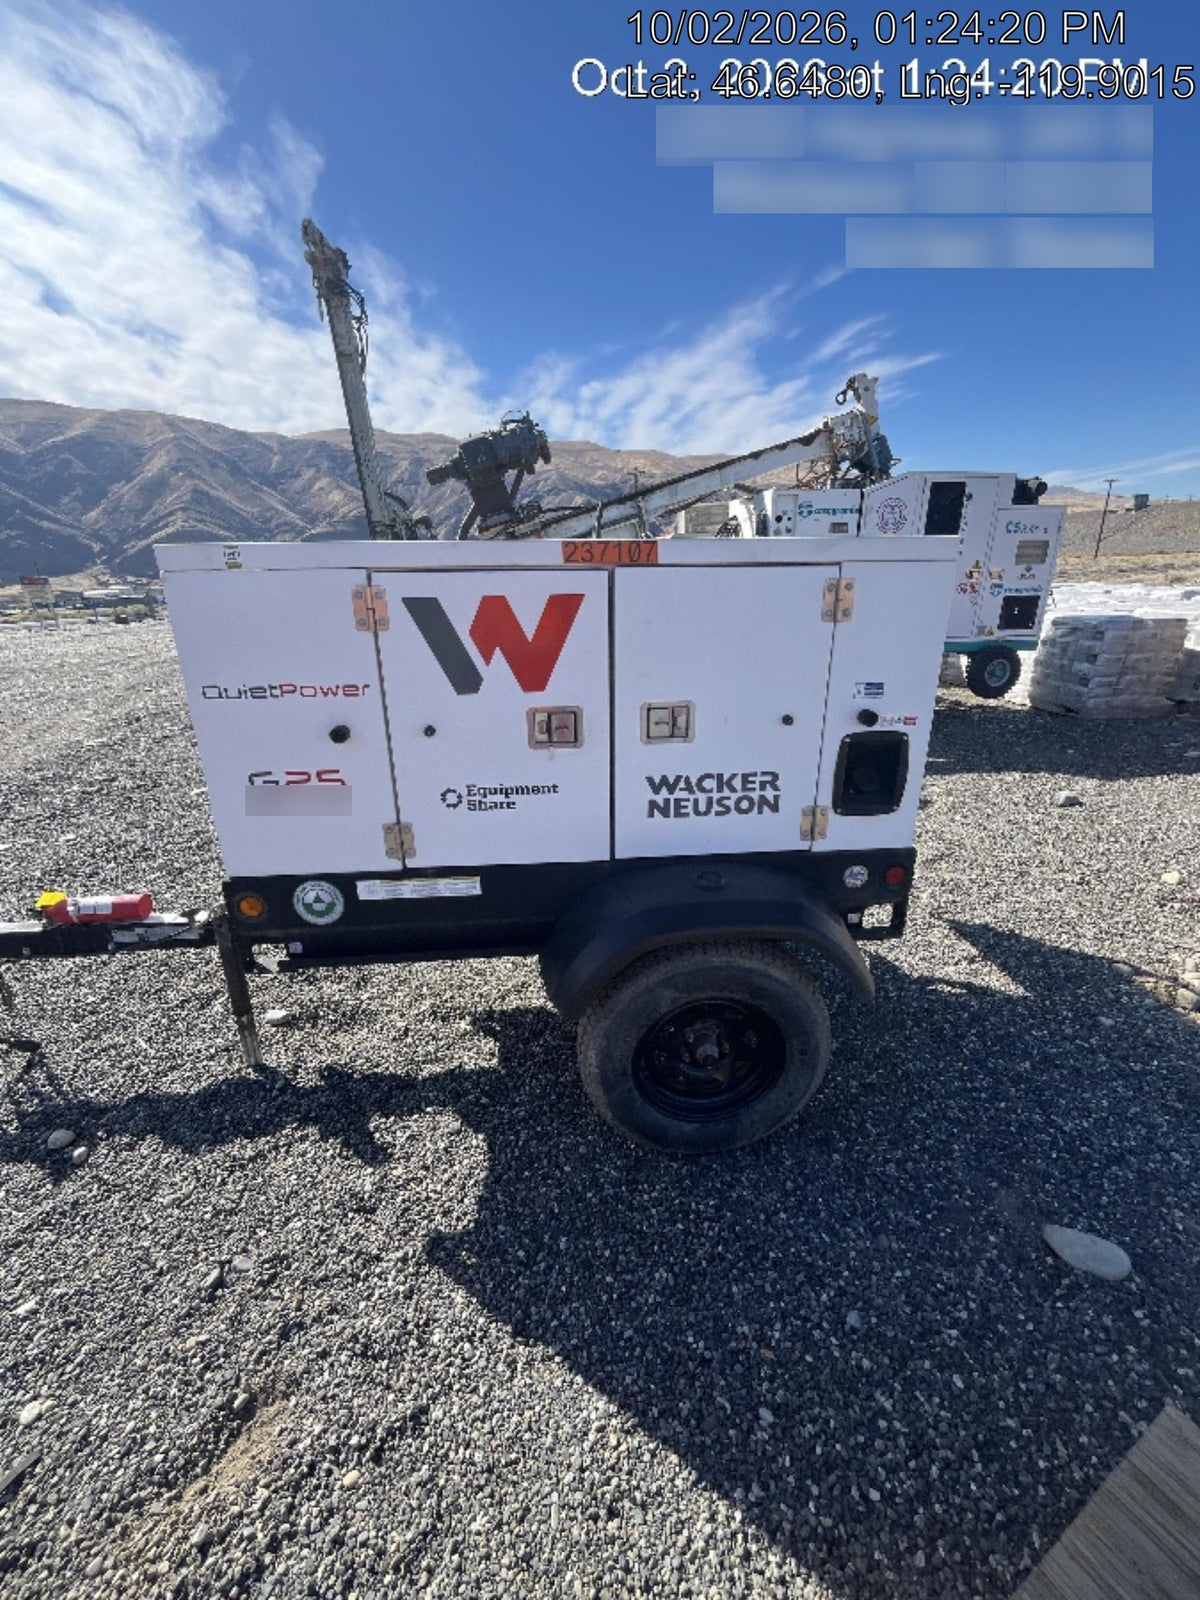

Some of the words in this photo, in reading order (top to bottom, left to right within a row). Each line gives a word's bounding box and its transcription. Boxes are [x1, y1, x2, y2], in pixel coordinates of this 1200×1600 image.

[564, 541, 656, 562] 237107
[201, 684, 371, 700] QuietPower
[466, 784, 559, 799] Equipment
[645, 771, 781, 796] WACKER
[467, 799, 517, 811] Share
[647, 794, 781, 819] NEUSON
